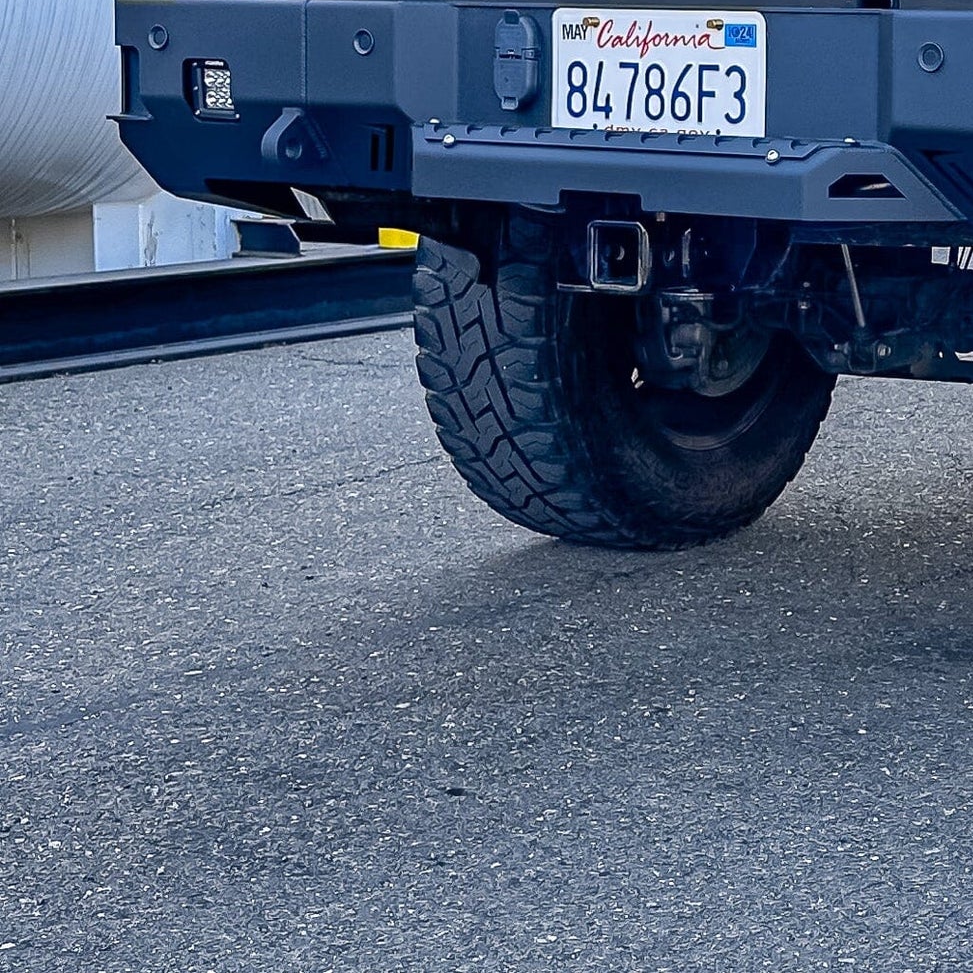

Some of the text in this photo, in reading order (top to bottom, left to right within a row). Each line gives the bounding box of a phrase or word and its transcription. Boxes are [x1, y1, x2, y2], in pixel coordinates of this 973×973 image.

[562, 23, 588, 41] MAY
[597, 19, 725, 58] California
[566, 60, 747, 125] 84786F3
